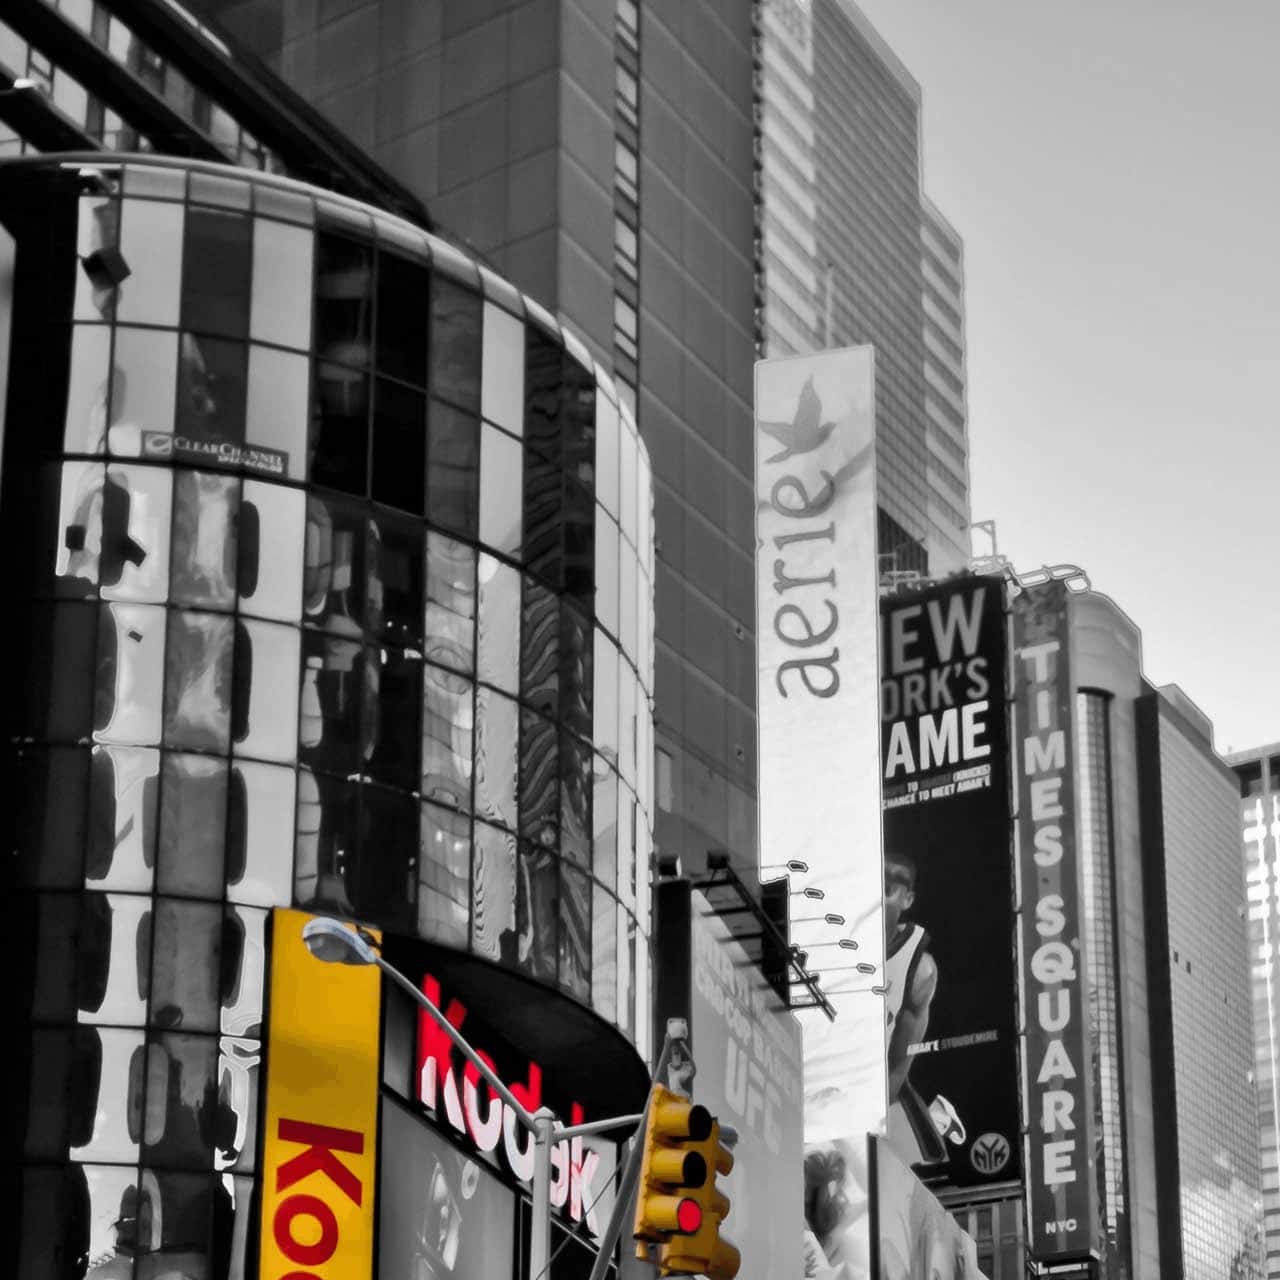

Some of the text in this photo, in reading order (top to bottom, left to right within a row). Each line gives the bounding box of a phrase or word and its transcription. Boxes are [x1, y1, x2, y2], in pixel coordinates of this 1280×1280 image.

[770, 471, 840, 699] aerie
[879, 588, 986, 675] EW
[1019, 640, 1077, 1187] TIMES SQUARE
[1045, 1218, 1078, 1234] NYC
